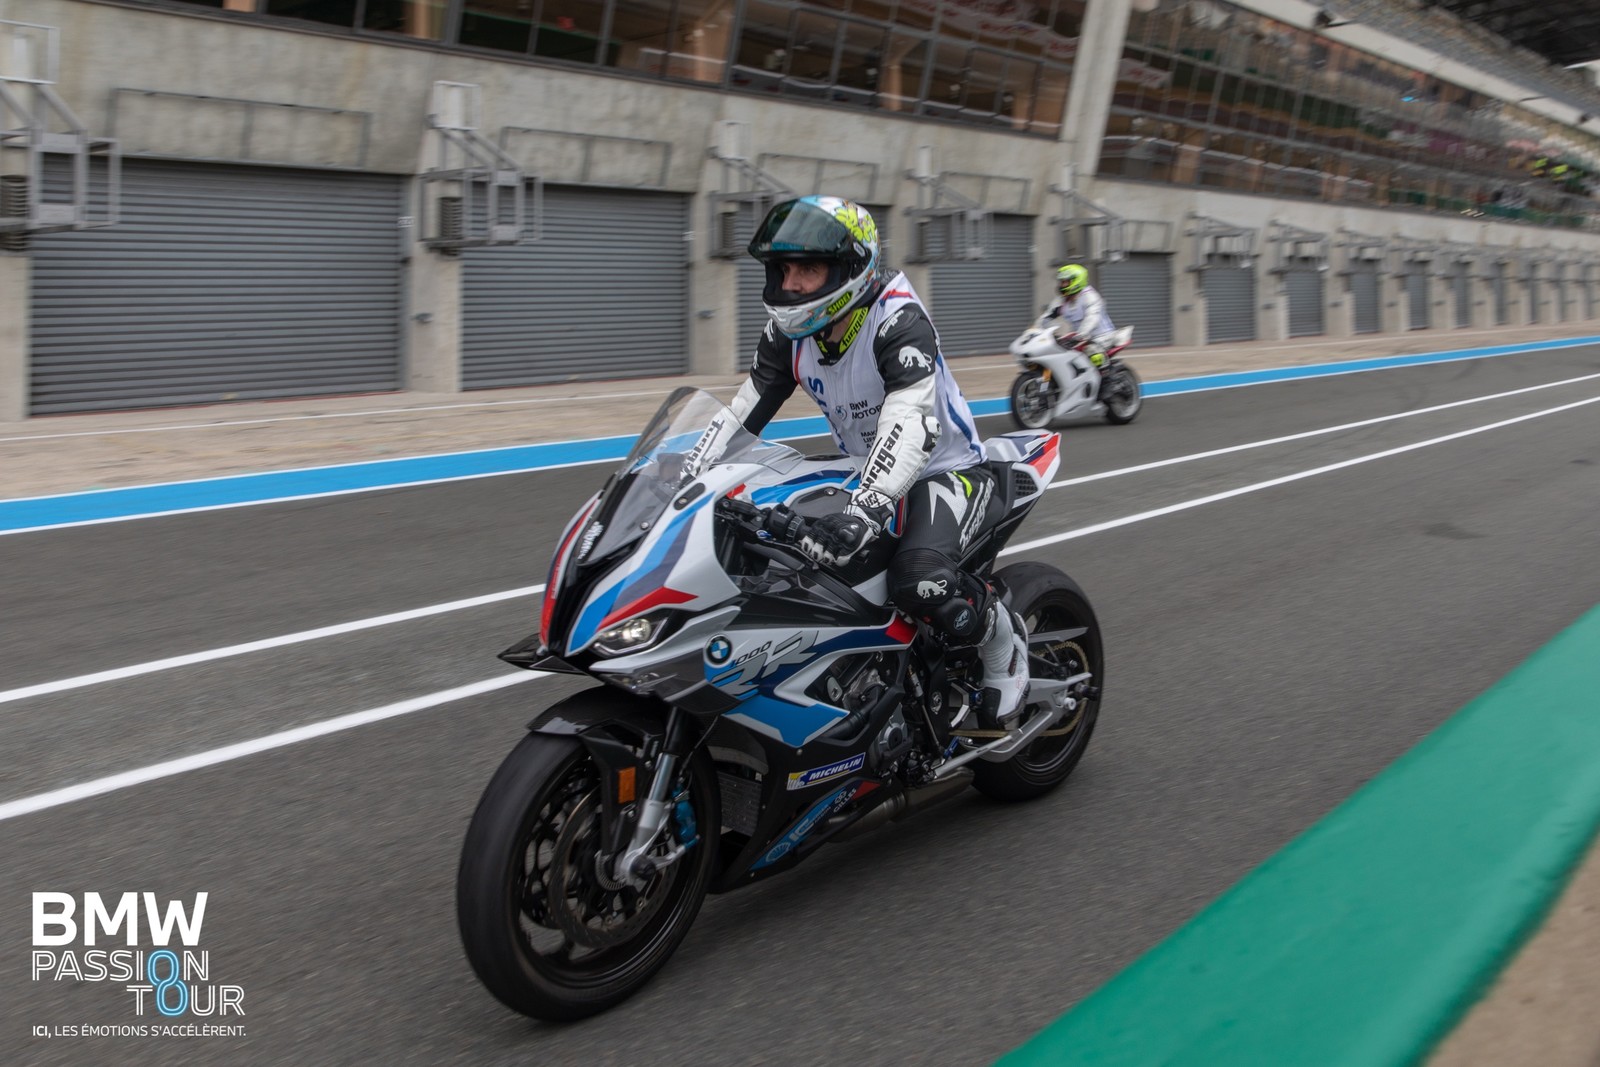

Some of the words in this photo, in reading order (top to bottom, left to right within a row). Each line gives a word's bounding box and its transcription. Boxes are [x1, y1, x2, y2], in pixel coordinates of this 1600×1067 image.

[828, 292, 851, 313] SHOEI
[842, 308, 867, 347] furygan
[851, 404, 882, 419] MOTOR
[861, 422, 903, 489] urygan
[808, 757, 862, 781] MICHELIN
